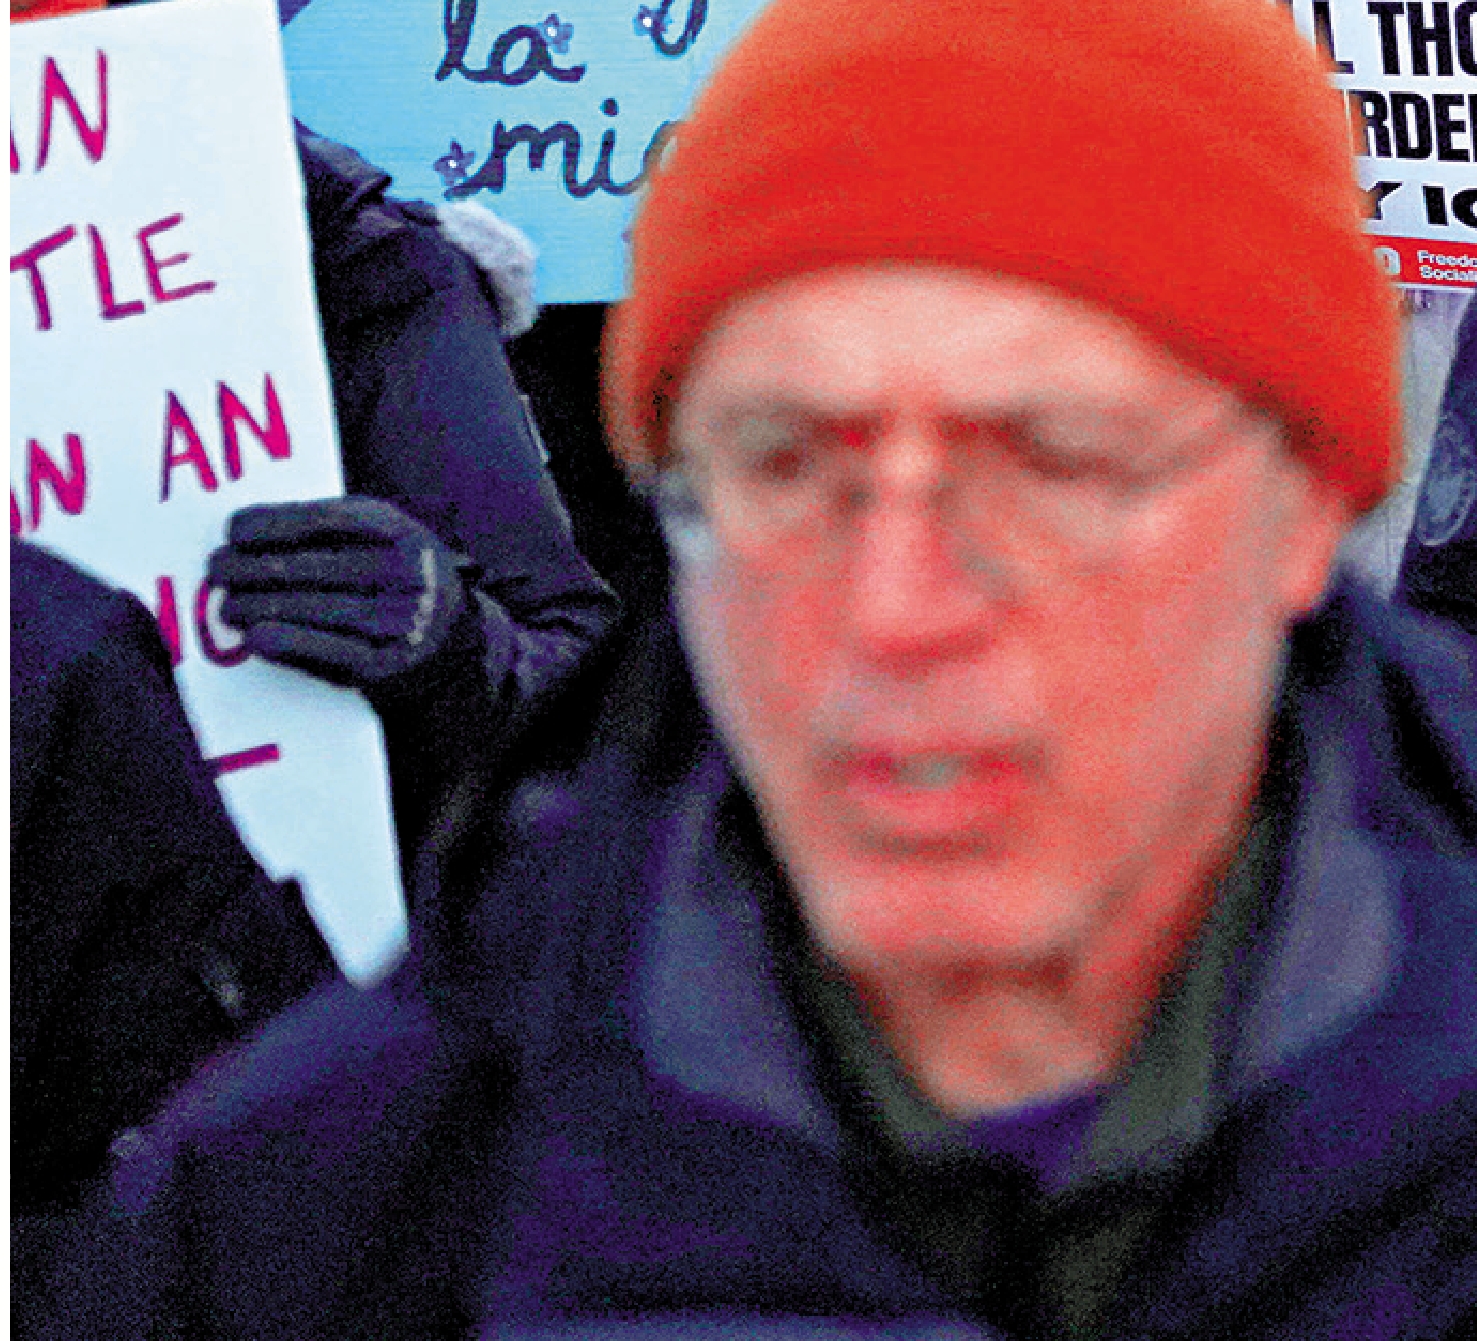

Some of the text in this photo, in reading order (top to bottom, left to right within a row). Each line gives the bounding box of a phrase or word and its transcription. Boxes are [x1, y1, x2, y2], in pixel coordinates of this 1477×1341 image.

[10, 49, 109, 174] N
[10, 372, 292, 537] N AN
